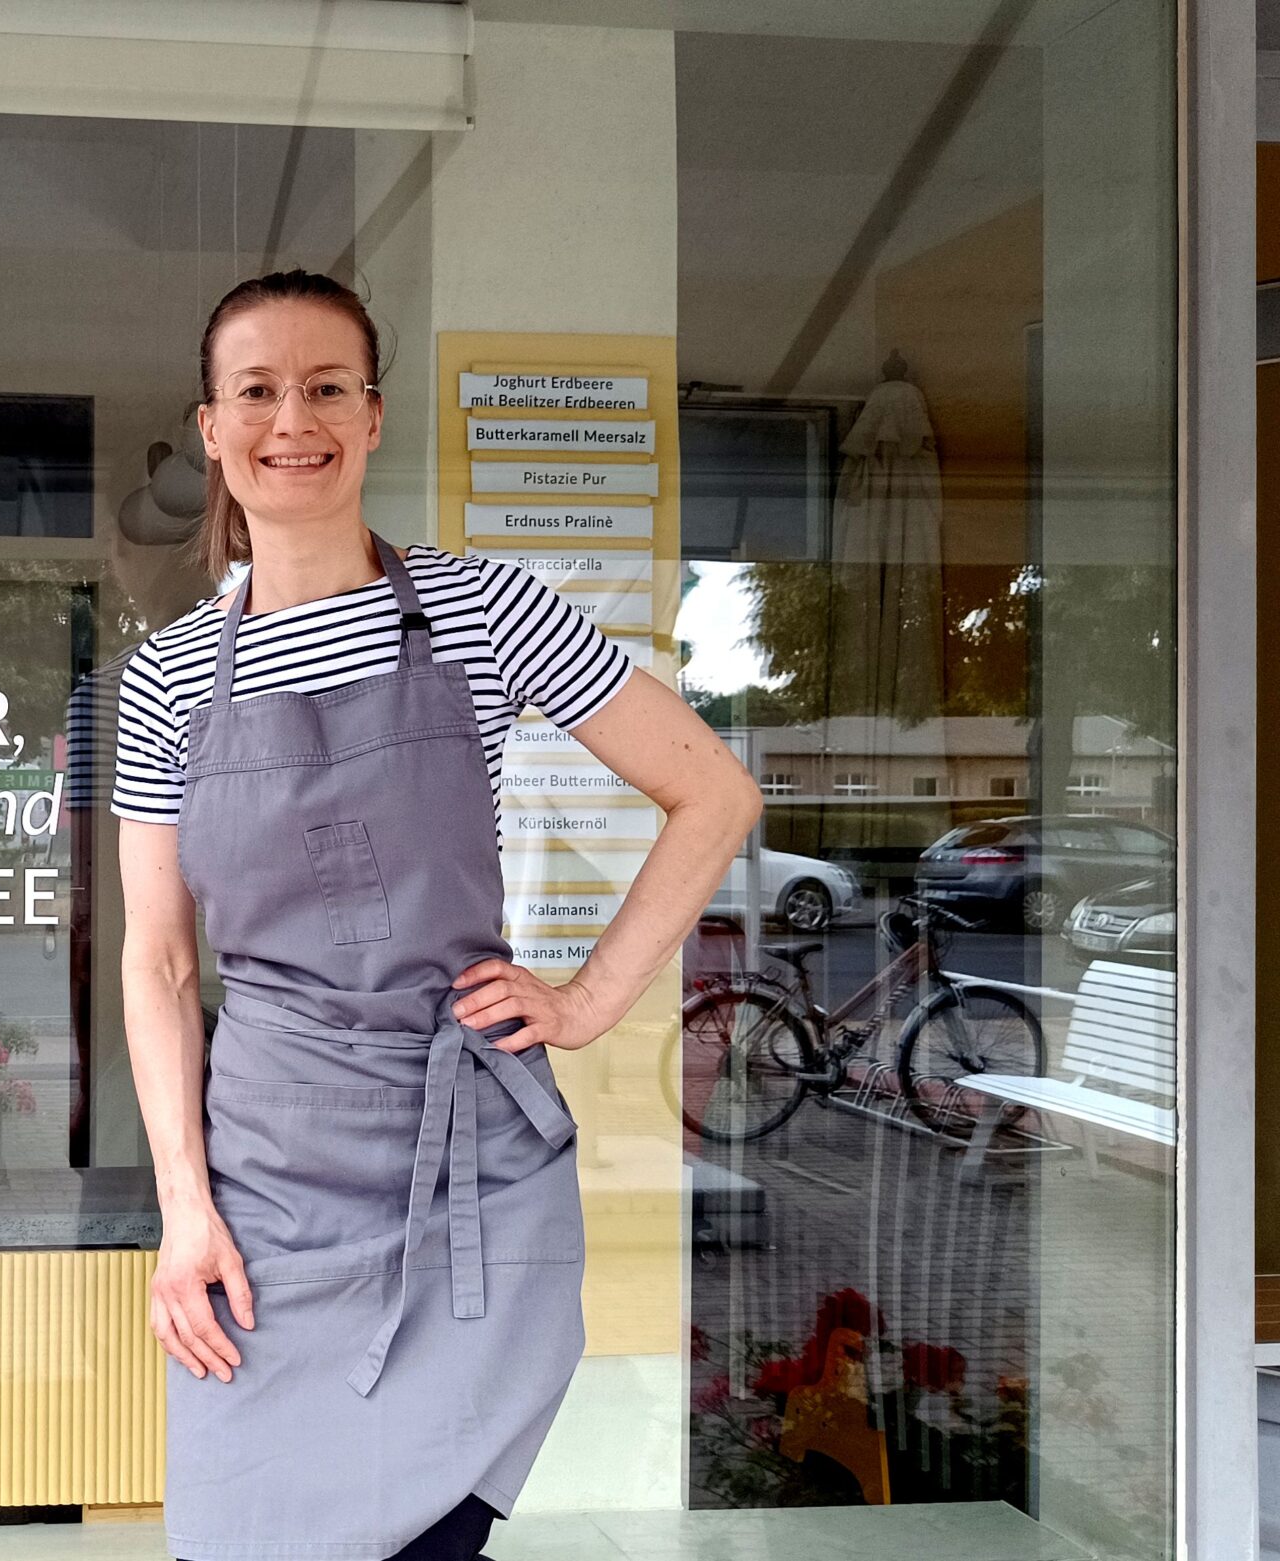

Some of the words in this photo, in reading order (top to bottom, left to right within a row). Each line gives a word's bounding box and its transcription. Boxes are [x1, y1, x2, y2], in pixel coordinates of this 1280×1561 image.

[493, 375, 546, 390] Joghurt
[551, 376, 614, 391] Erdbeere
[471, 393, 494, 407] mit
[498, 394, 561, 408] Beelitzer
[564, 395, 636, 409] Erdbeeren
[475, 427, 579, 443] Butterkaramell
[583, 429, 646, 444] Meersalz
[522, 471, 578, 485] Pistazie
[582, 472, 607, 485] Pur
[504, 514, 560, 528] Erdnuss
[517, 557, 603, 571] Stracciatella
[501, 774, 546, 787] mbeer
[518, 816, 607, 830] Kürbiskernöl
[527, 903, 599, 916] Kalamansi
[513, 947, 563, 959] Ananas
